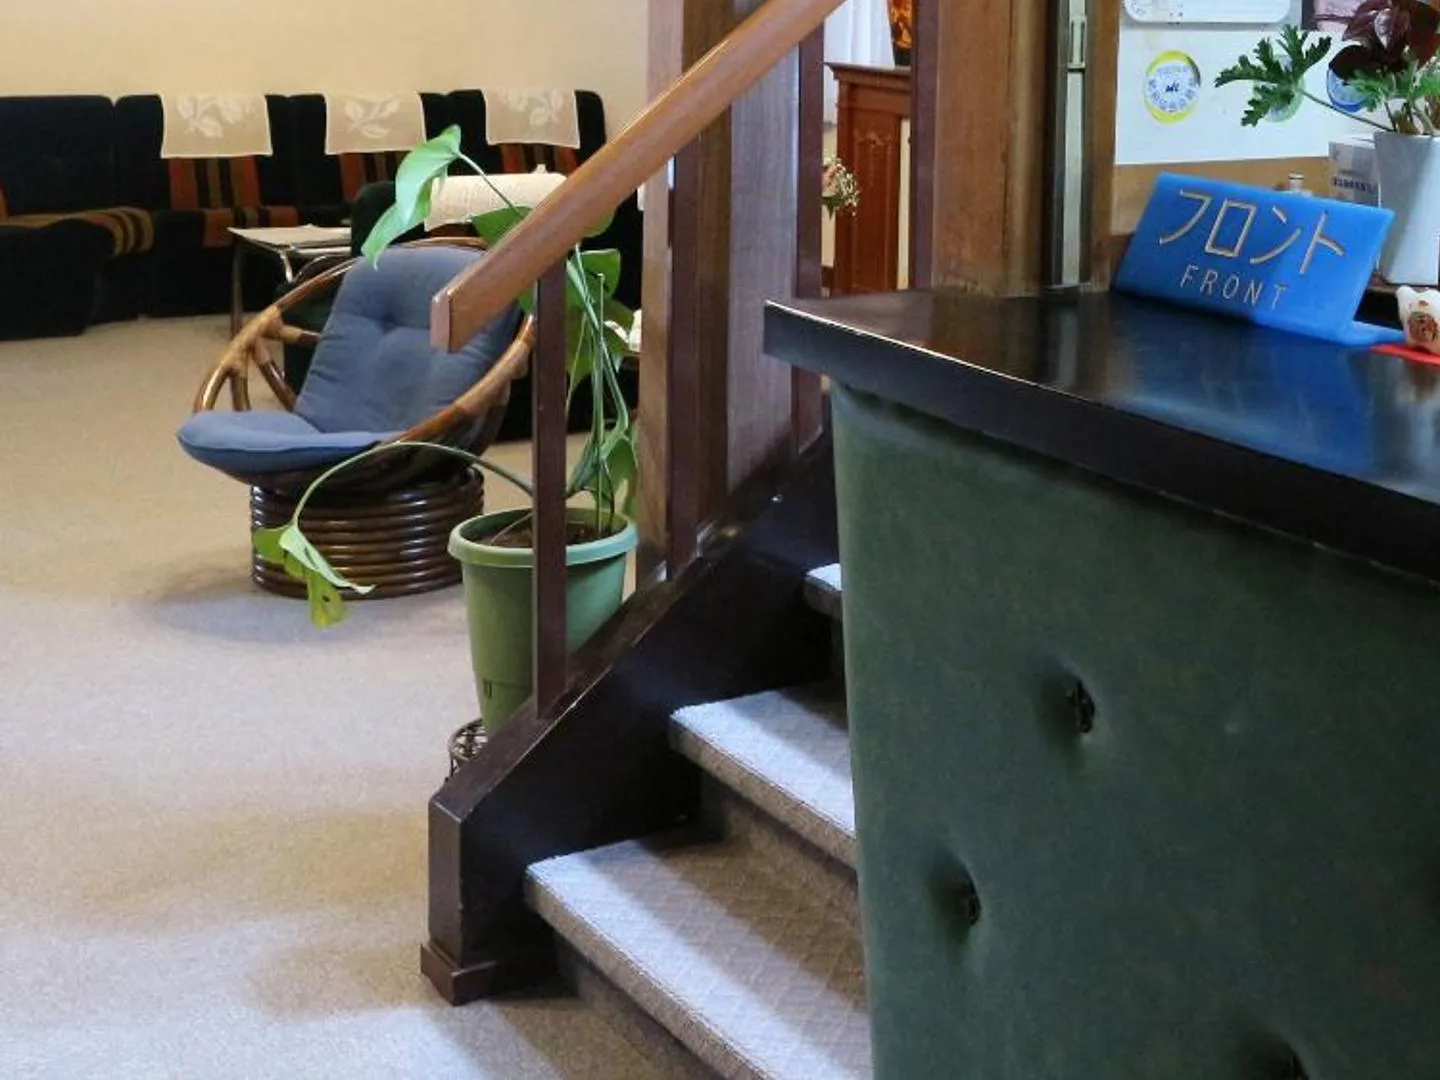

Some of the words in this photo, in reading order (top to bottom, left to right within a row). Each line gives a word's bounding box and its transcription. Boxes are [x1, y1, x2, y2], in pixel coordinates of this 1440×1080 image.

[1159, 188, 1347, 275] フロント
[1180, 263, 1288, 310] FRONT
